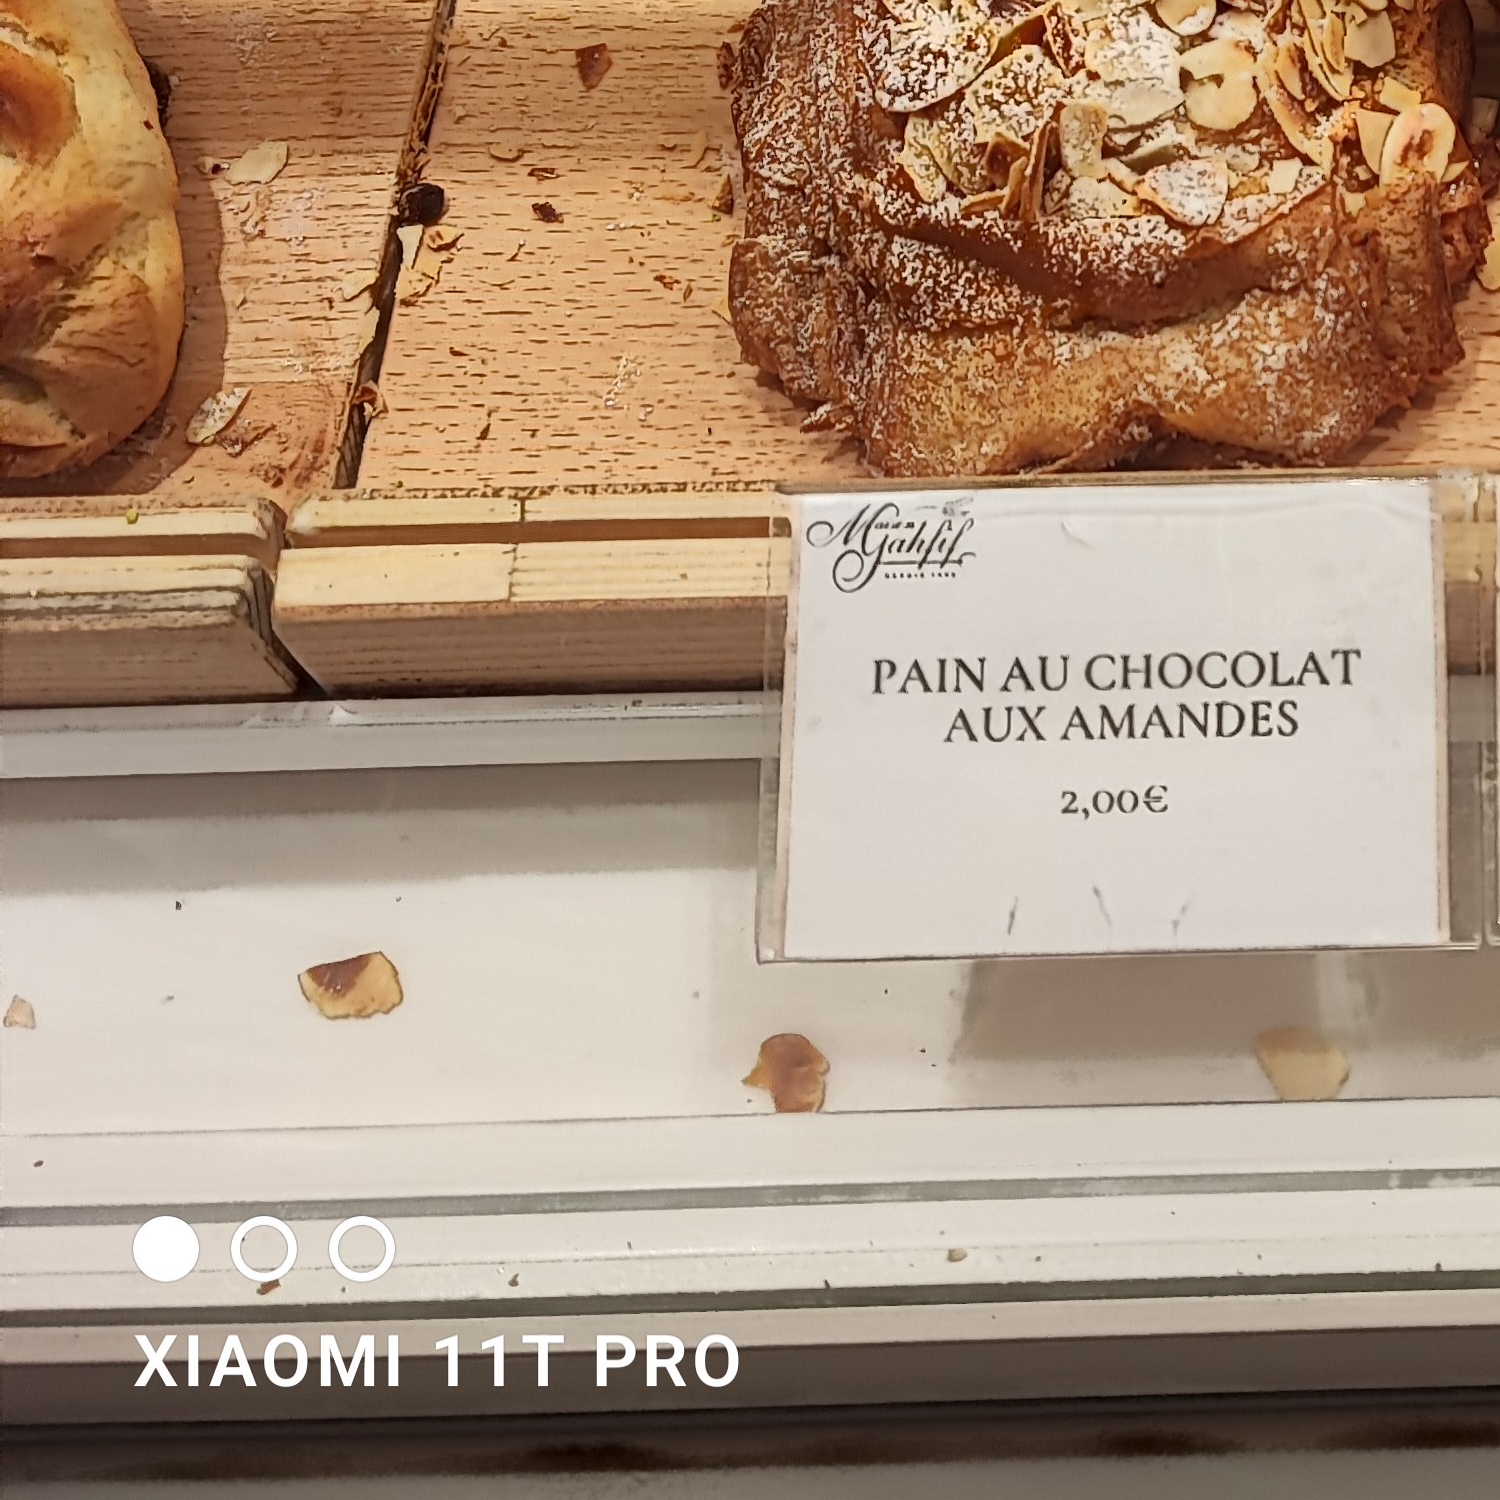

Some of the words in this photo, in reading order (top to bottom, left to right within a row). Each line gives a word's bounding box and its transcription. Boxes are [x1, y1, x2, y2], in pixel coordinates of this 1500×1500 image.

[872, 656, 987, 695] PAIN
[999, 654, 1070, 693] AU
[1084, 648, 1362, 692] CHOCOLAT
[943, 705, 1047, 743] AUX
[1059, 699, 1299, 741] AMANDES
[1060, 784, 1169, 820] 2,00€
